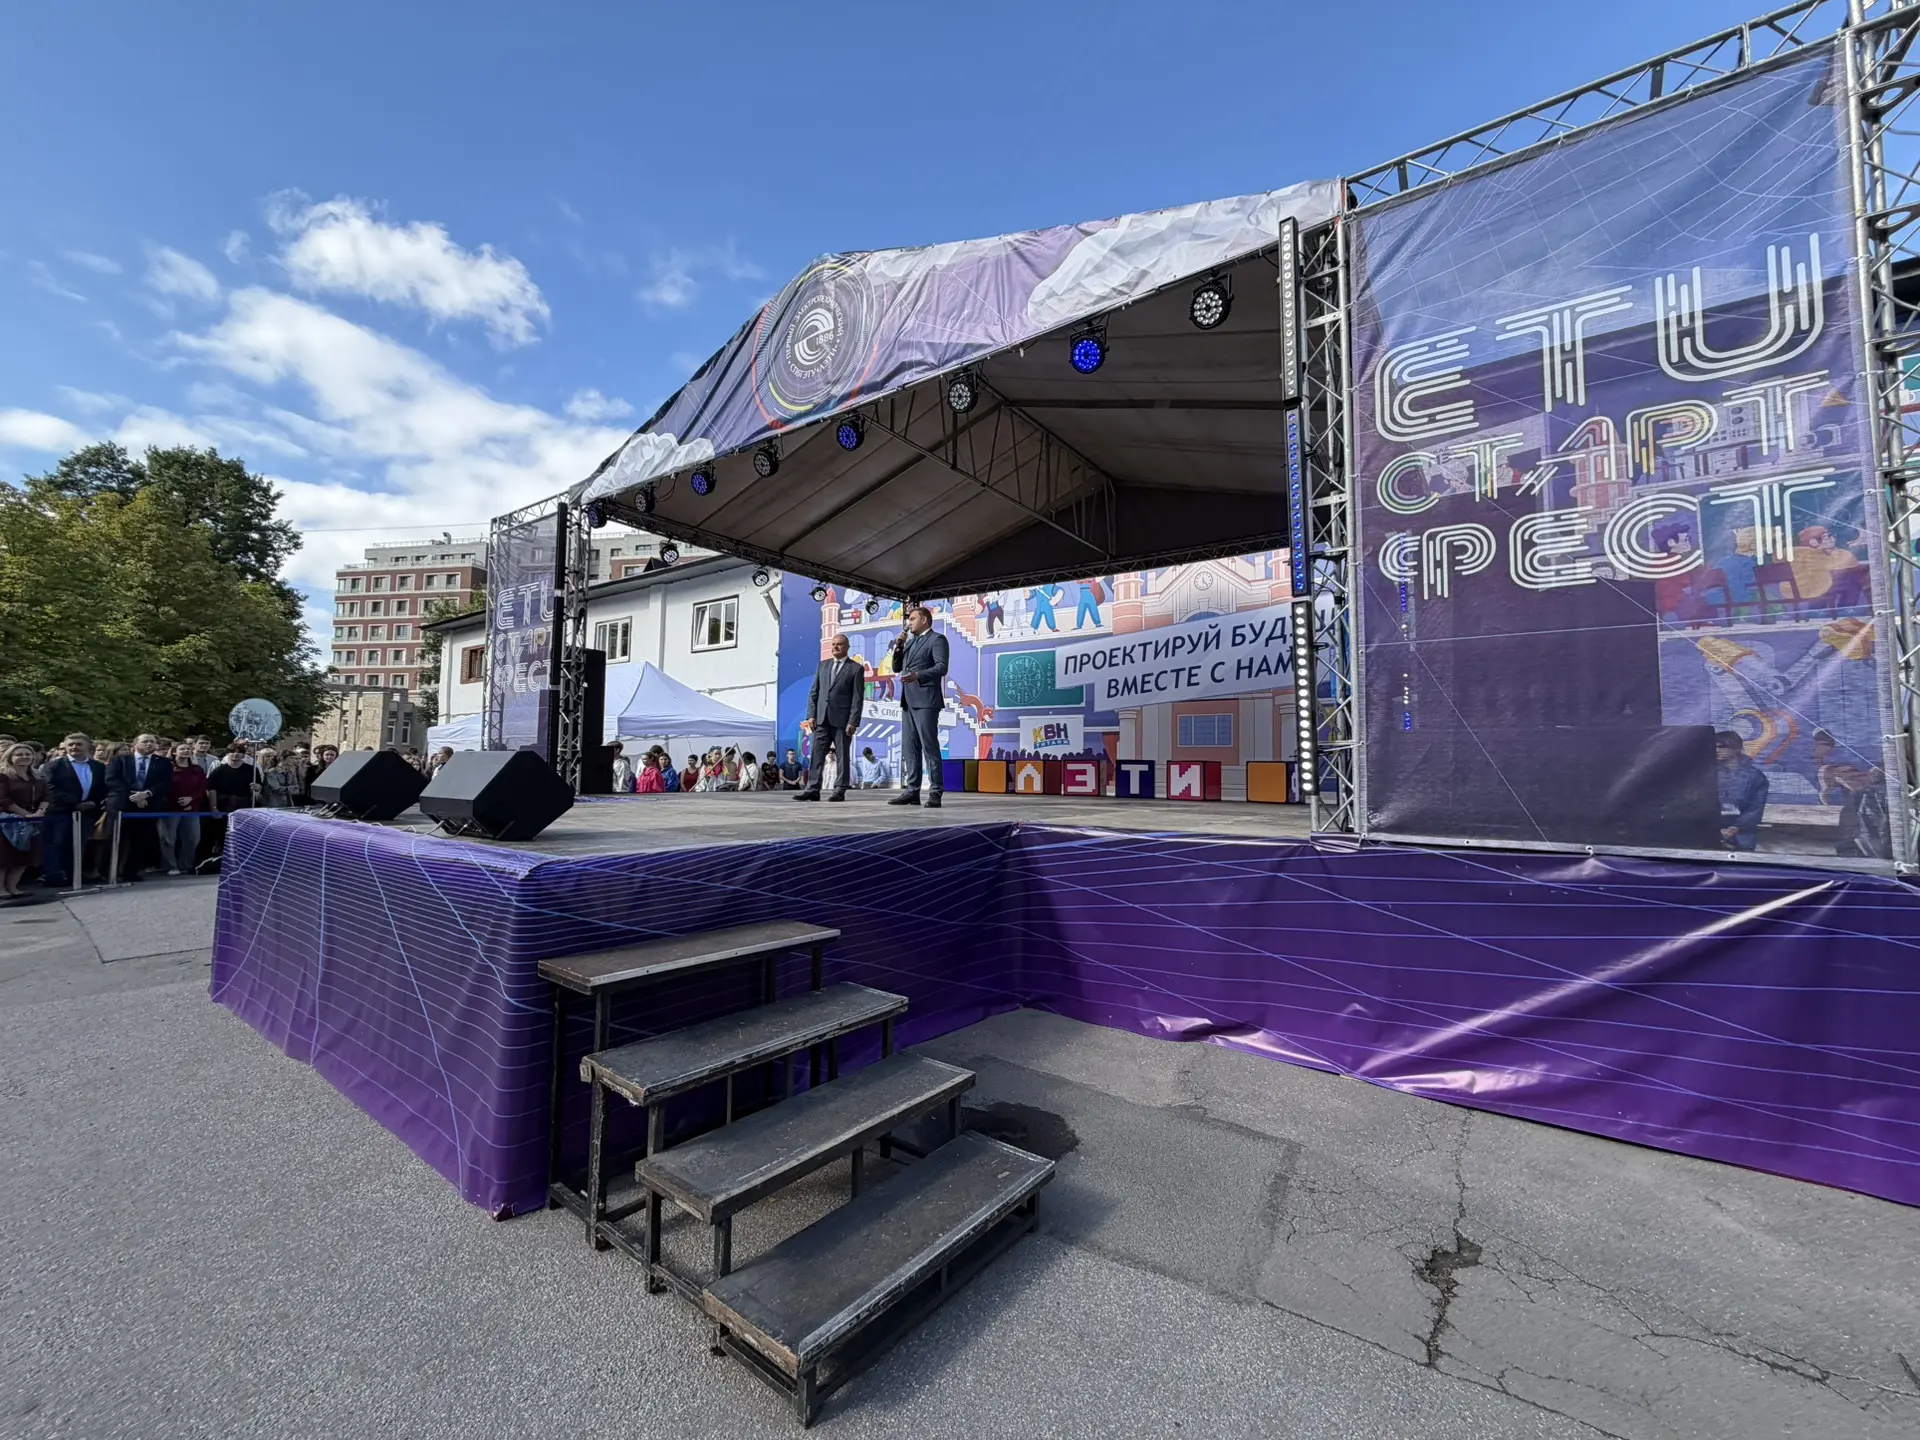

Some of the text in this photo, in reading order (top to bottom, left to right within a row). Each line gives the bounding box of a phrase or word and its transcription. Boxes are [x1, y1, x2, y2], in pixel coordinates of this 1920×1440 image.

[816, 332, 834, 346] 1886
[1375, 233, 1823, 441] ETU
[1376, 370, 1829, 514] СТАРТ
[1378, 468, 1835, 600] ФЕСТ
[1064, 623, 1221, 675] ПРОЕКТИРУЙ
[1106, 652, 1318, 698] ВМЕСТЕ С НАМ
[882, 708, 902, 717] СПбГ
[1032, 723, 1069, 744] КВН
